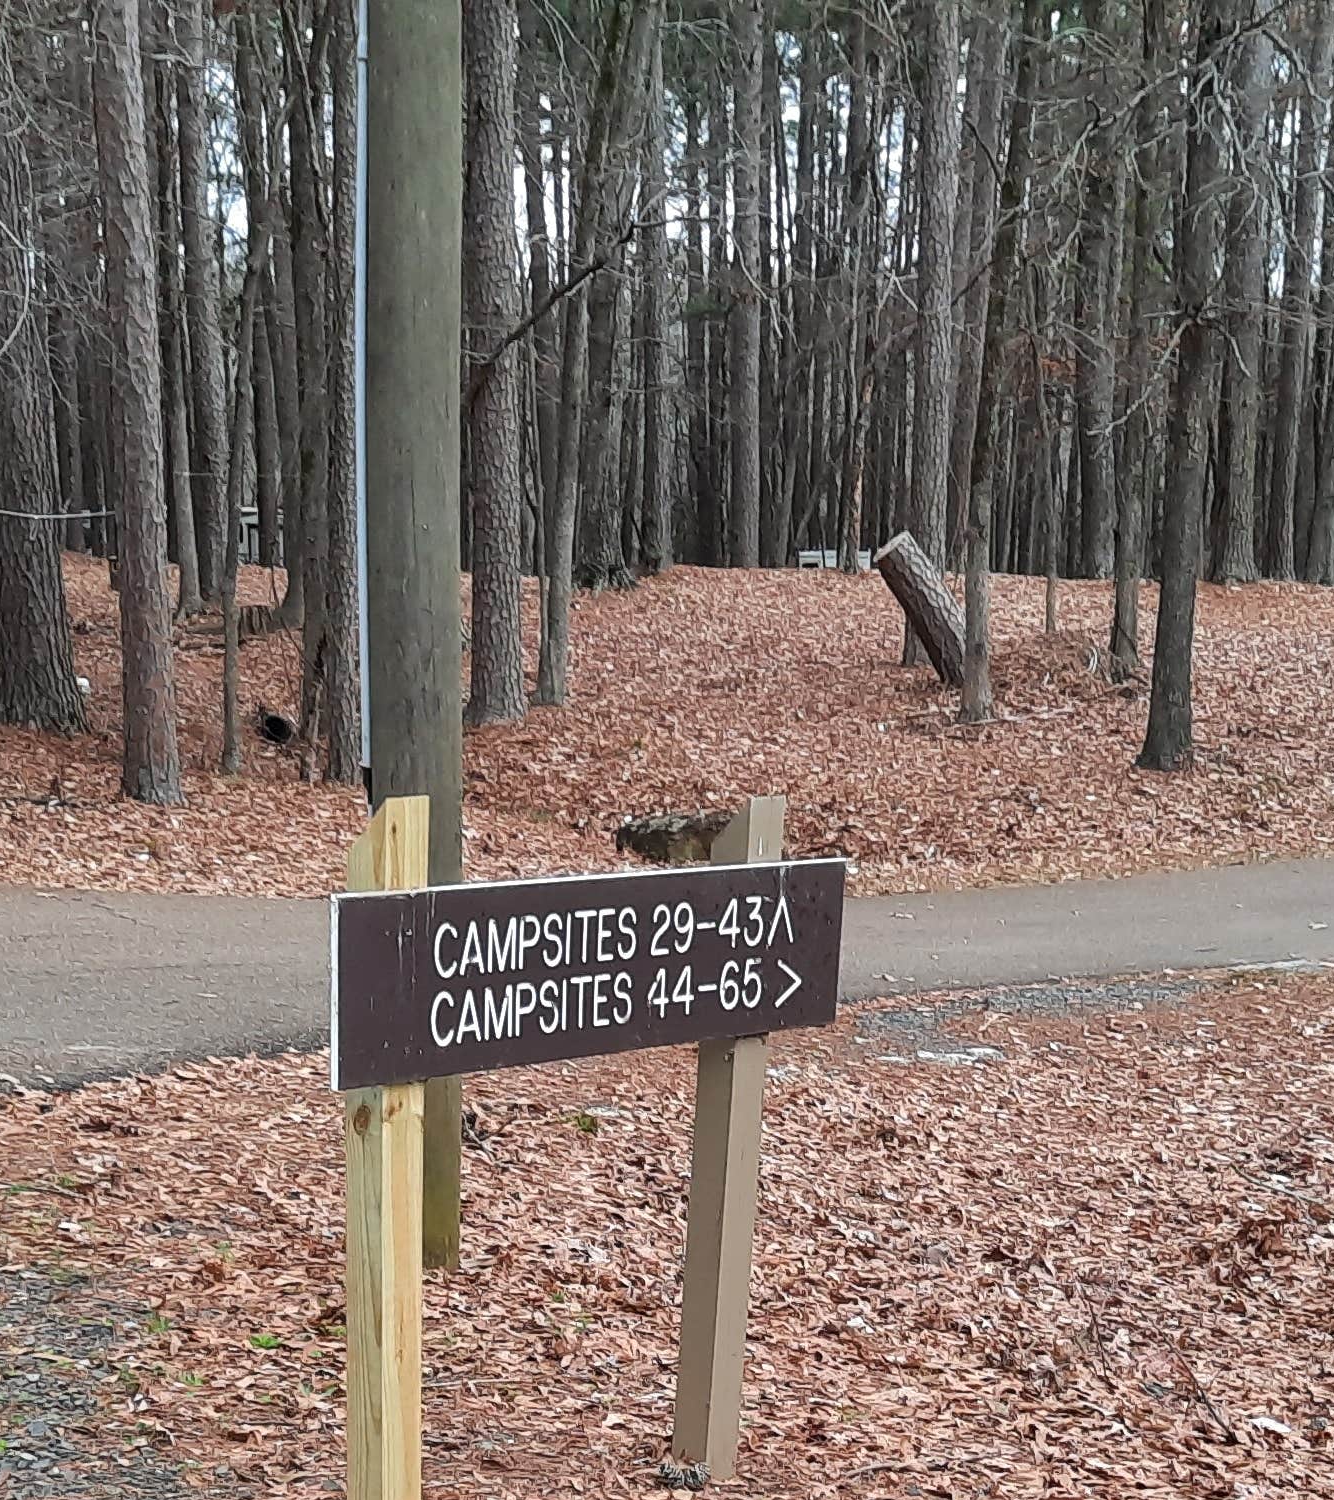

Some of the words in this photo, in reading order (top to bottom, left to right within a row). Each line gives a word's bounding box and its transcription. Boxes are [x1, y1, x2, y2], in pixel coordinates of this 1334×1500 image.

[433, 906, 637, 979] CAMPSITES
[649, 896, 764, 956] 29-43
[430, 971, 634, 1047] CAMPSITES
[647, 958, 763, 1018] 44-65
